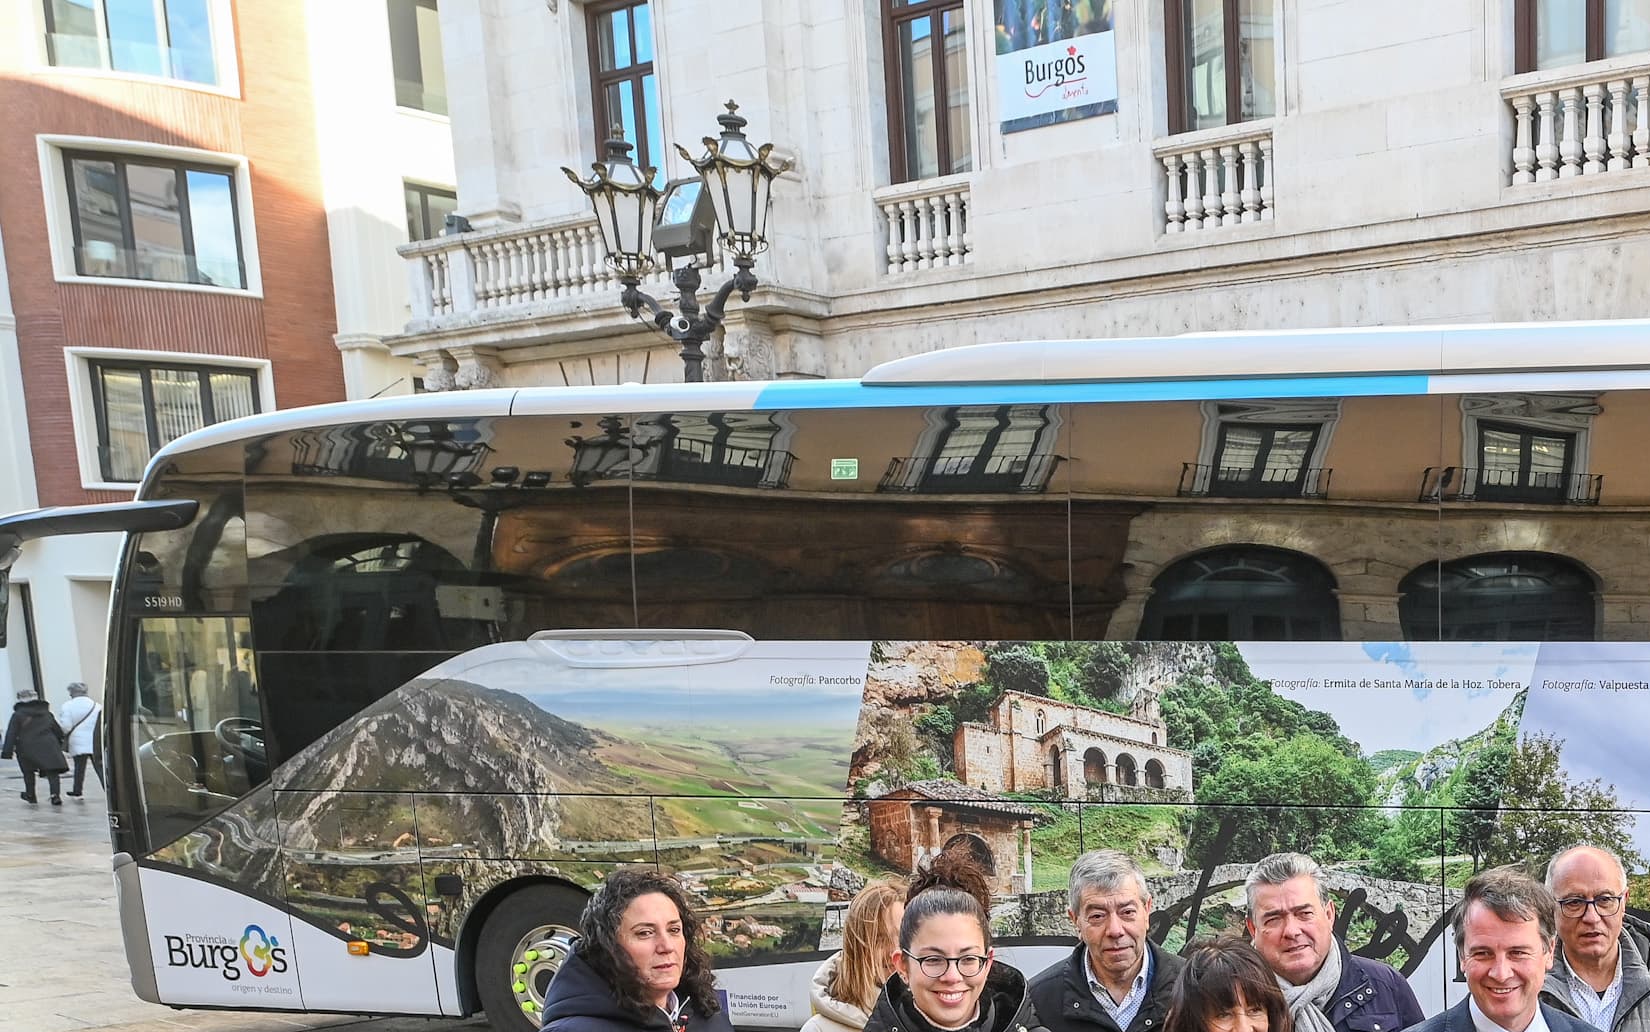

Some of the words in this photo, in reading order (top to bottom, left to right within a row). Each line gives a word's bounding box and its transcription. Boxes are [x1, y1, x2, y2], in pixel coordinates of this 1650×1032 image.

[1024, 54, 1086, 87] Burgos
[144, 596, 151, 607] S
[151, 596, 167, 607] 519
[168, 596, 182, 607] HD
[769, 674, 816, 687] Fotografía:
[818, 675, 861, 685] Pancorbo
[1323, 678, 1357, 688] Ermita
[1359, 678, 1372, 688] de
[1373, 679, 1402, 689] Santa
[1404, 679, 1433, 689] María
[1435, 679, 1448, 689] de
[1450, 679, 1460, 689] la
[1462, 679, 1484, 689] Hoz.
[1486, 679, 1521, 689] Tobera
[1542, 679, 1597, 692] Fotografía:
[1599, 679, 1649, 692] Valpuesta
[185, 933, 227, 945] Provincia
[164, 925, 288, 981] Burgos
[231, 983, 256, 994] origen
[257, 985, 262, 993] y
[264, 984, 293, 995] destino
[729, 993, 766, 1001] Financiado
[738, 1001, 758, 1009] Unión
[759, 1002, 787, 1010] Europea
